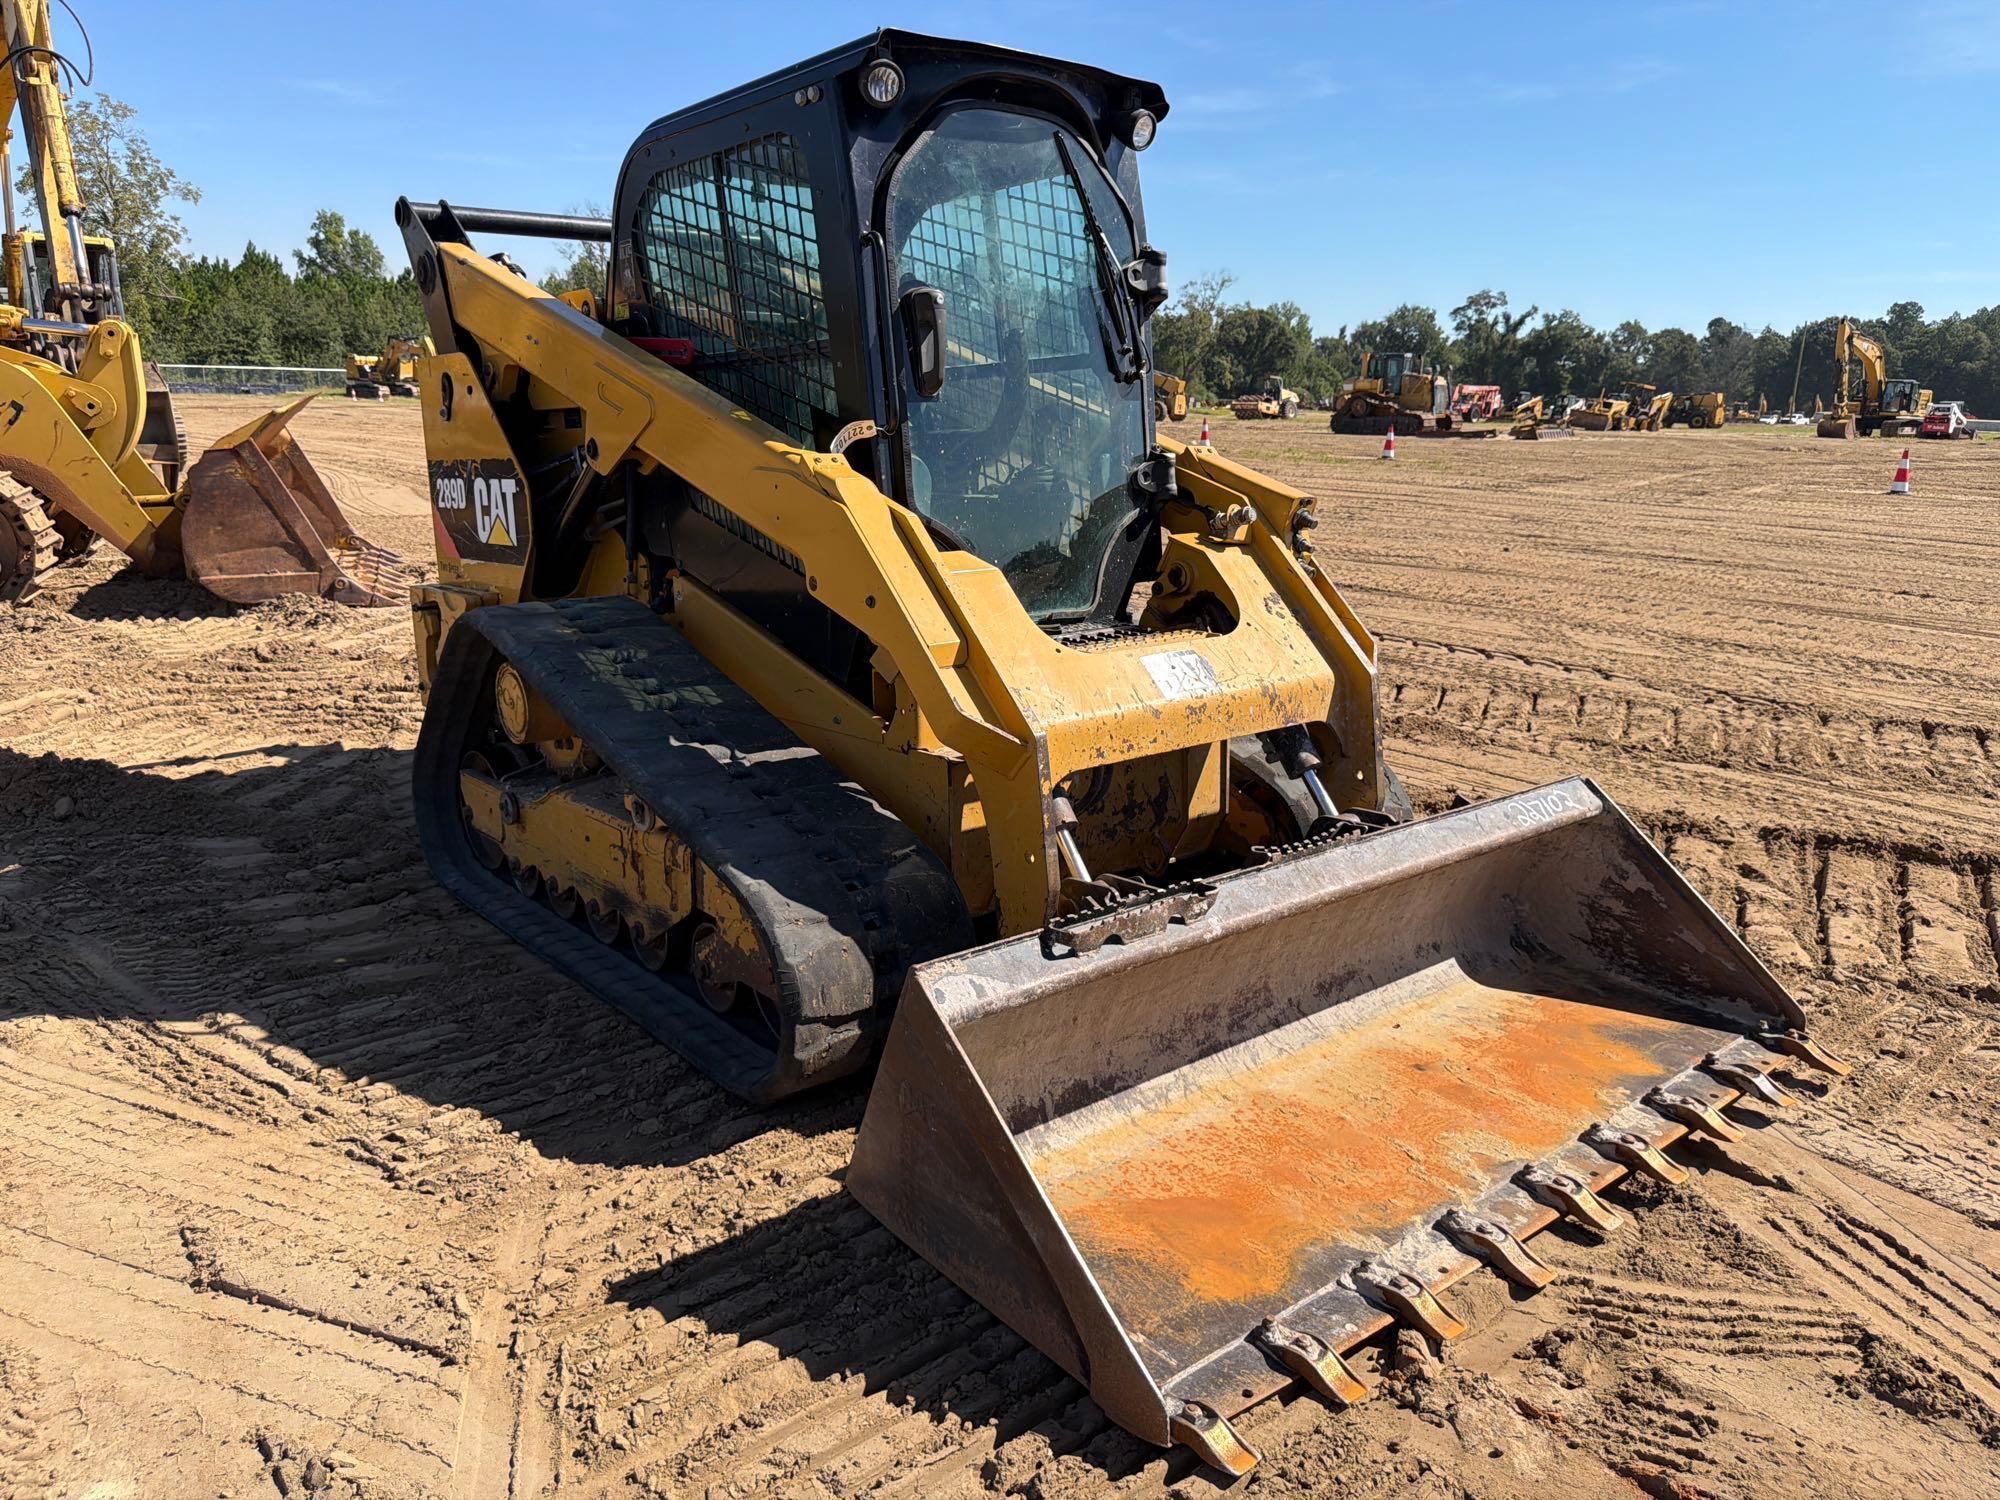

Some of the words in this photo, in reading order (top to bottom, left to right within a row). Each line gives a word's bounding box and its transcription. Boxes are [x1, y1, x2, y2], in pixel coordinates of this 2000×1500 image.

[835, 426, 864, 453] 227102
[436, 478, 466, 509] 289D
[474, 477, 517, 547] CAT
[1507, 789, 1584, 827] 227102
